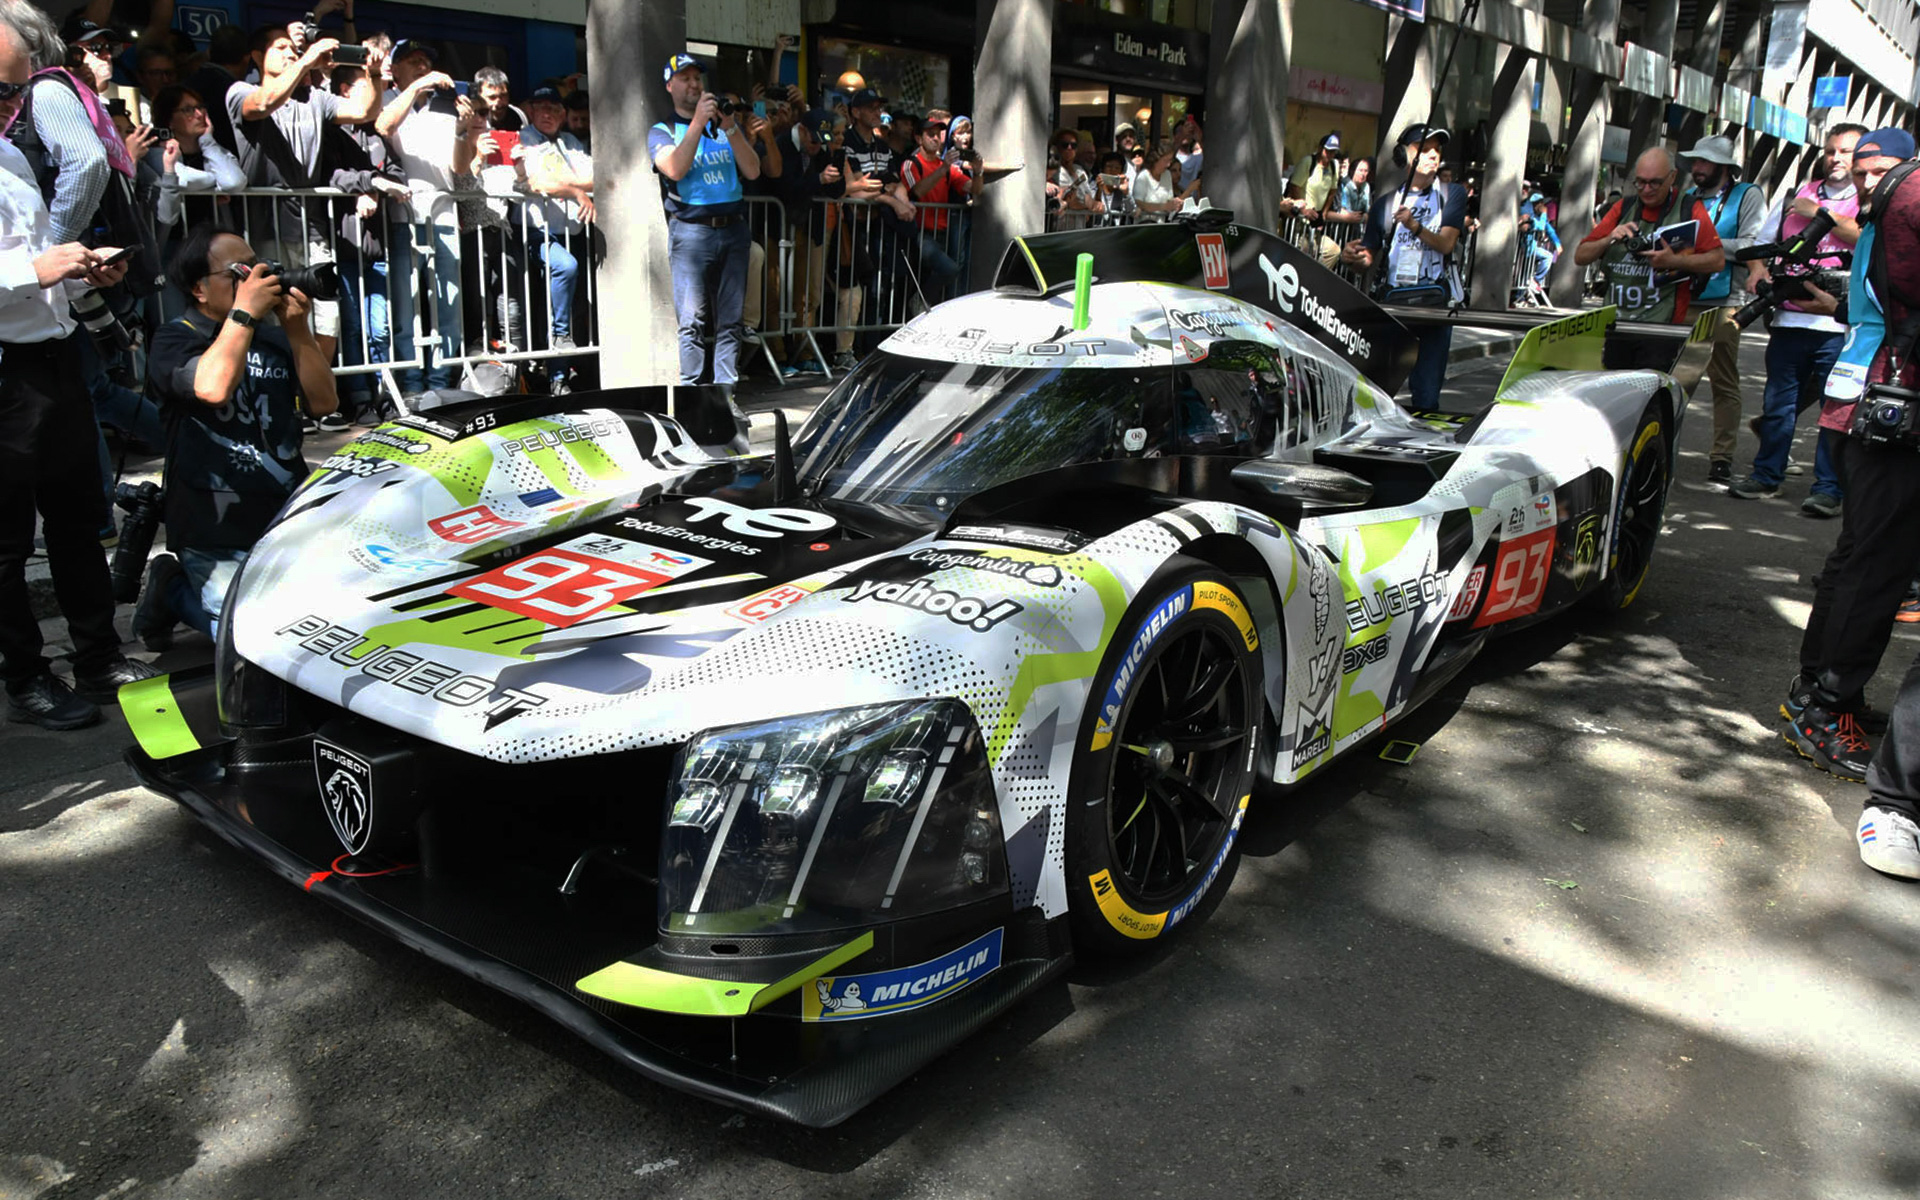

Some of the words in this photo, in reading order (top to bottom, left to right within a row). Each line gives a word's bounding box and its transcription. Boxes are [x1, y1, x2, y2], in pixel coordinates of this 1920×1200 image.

[188, 12, 221, 36] 50
[1115, 32, 1143, 57] Eden
[1160, 42, 1187, 66] Park
[704, 149, 732, 165] LIVE
[703, 170, 725, 185] 064
[1201, 243, 1225, 278] HY
[1300, 285, 1372, 360] TotalEnergies
[1538, 310, 1603, 347] PEUGEOT
[465, 412, 497, 435] #93
[501, 419, 623, 457] PEUGEOT
[320, 450, 398, 478] ahoo!
[615, 516, 763, 556] TotalEnergies
[908, 548, 1028, 577] Capgemini
[1485, 540, 1551, 616] 93
[466, 556, 650, 616] 93
[1199, 590, 1219, 600] PILOT
[1219, 593, 1239, 611] SPORT
[1345, 569, 1451, 633] EUGEOT
[842, 578, 1021, 631] yahoo!
[1114, 593, 1186, 699] MICHELIN
[1245, 626, 1257, 646] M
[274, 614, 549, 722] PEUGEOT
[1342, 634, 1390, 675] 9X8
[320, 748, 368, 777] PEUGEOT
[1293, 741, 1331, 770] MARELLI
[1169, 834, 1234, 929] MICHELIN
[1117, 912, 1141, 931] SPORT
[1139, 922, 1160, 932] PILOT
[871, 947, 990, 1003] MICHELIN
